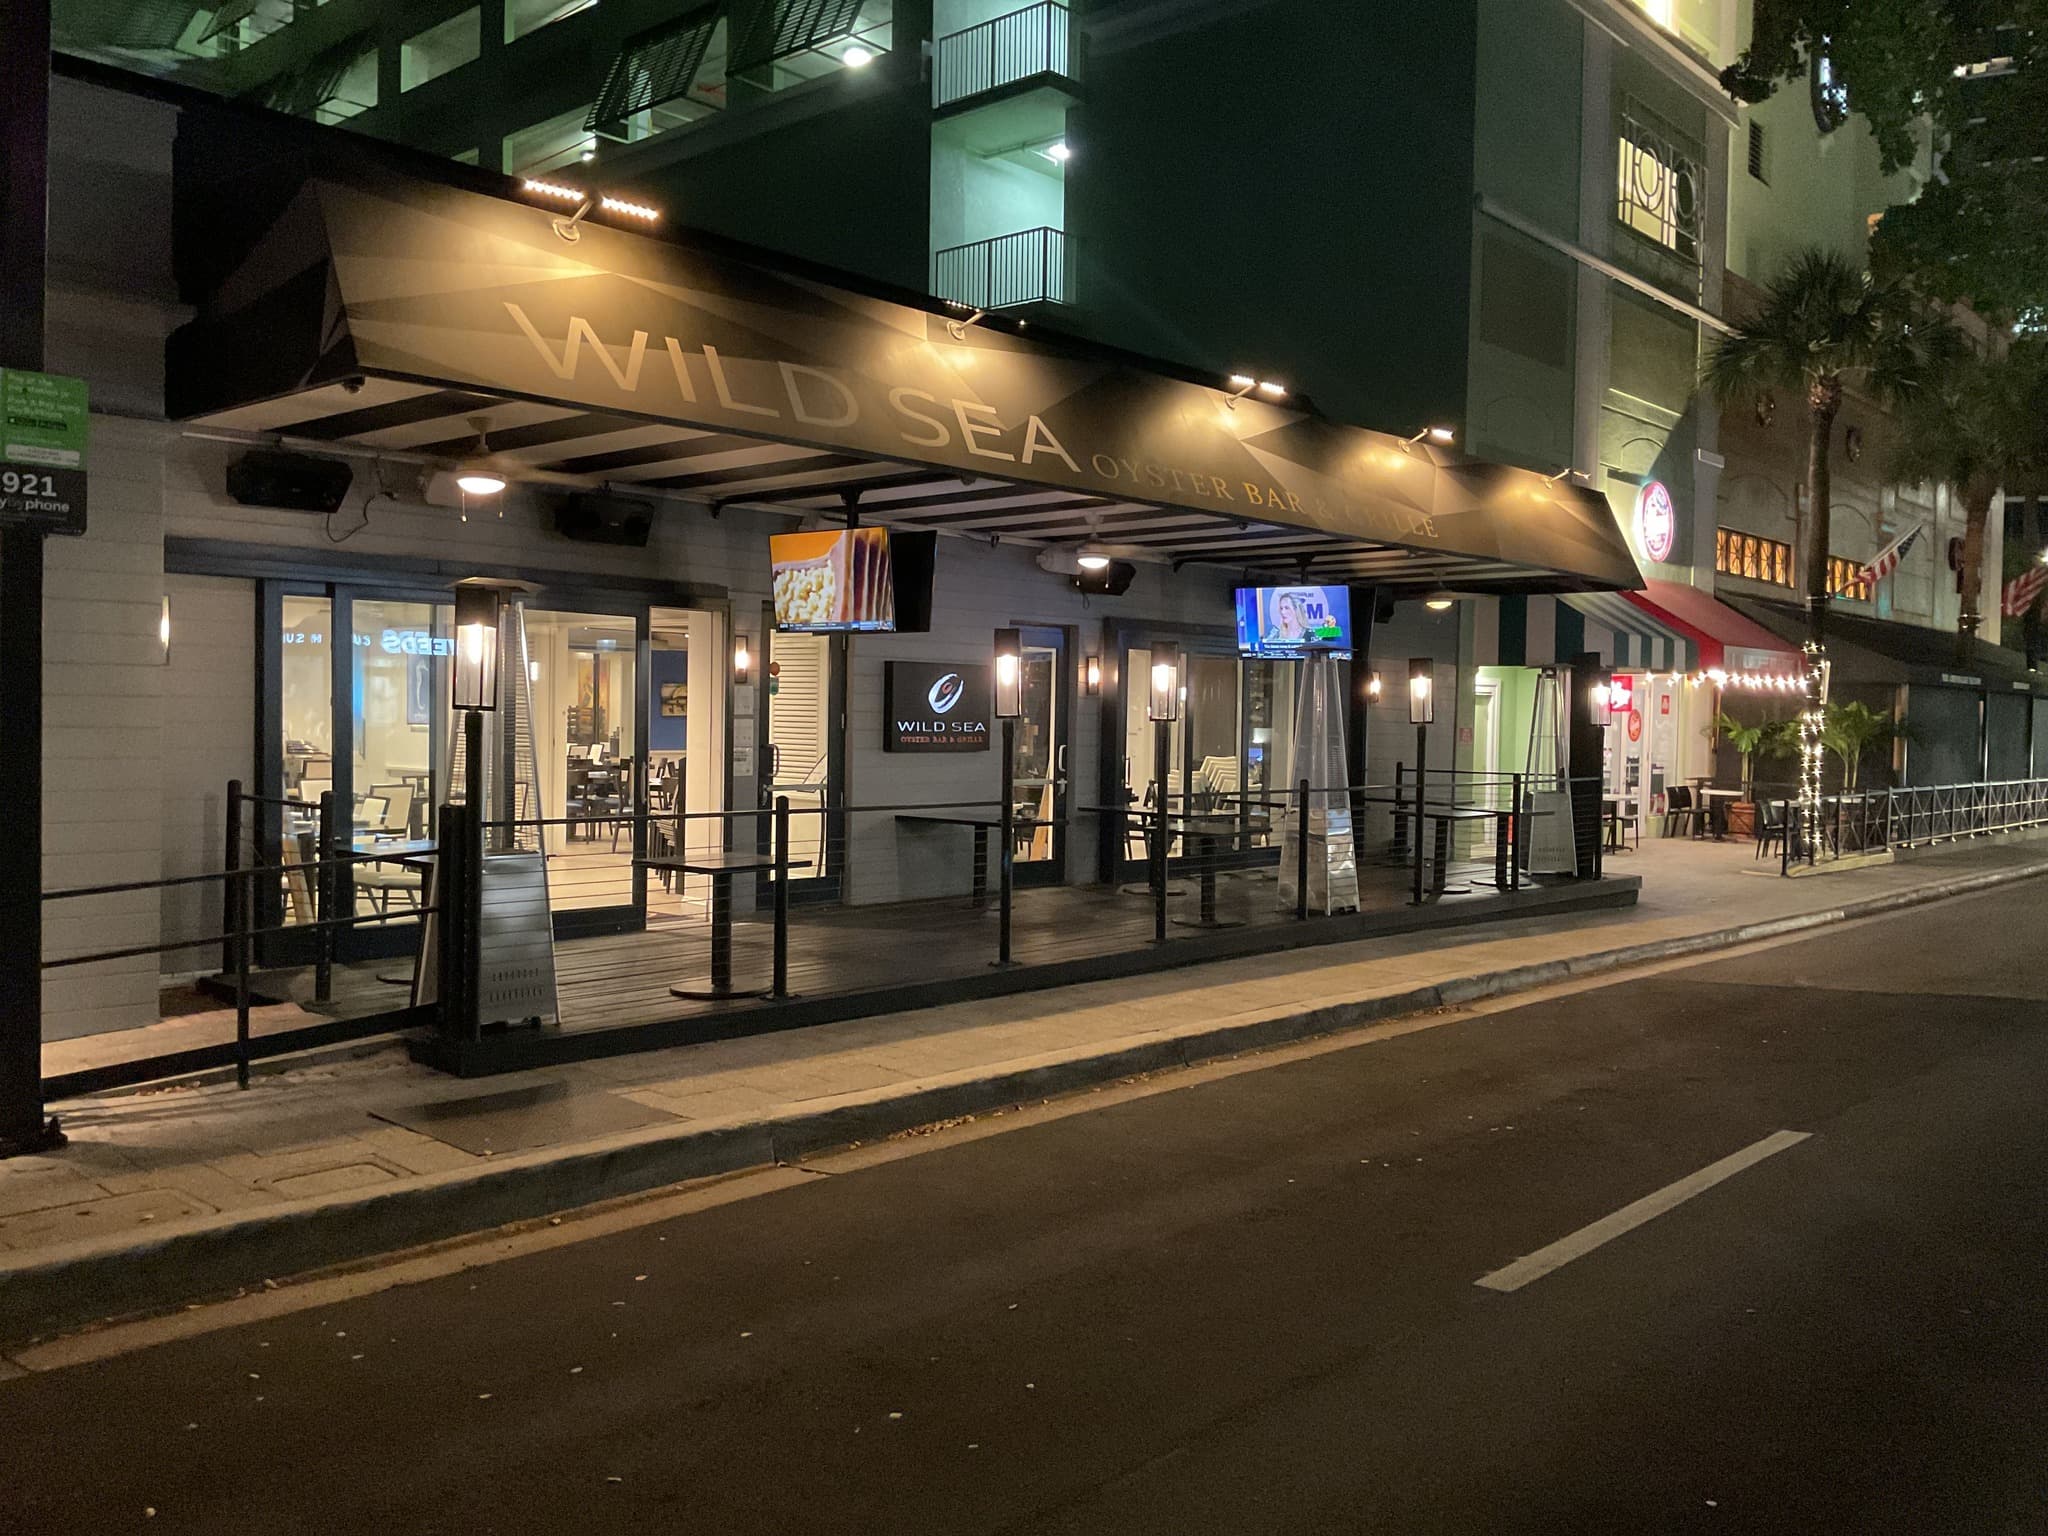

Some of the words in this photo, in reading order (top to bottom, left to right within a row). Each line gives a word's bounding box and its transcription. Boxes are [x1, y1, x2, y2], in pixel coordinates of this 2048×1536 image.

[504, 302, 860, 428] WILD
[888, 387, 1081, 472] SEA
[2, 471, 57, 497] 921
[1091, 454, 1235, 501] OYSTER
[1243, 481, 1307, 515] BAR
[897, 721, 945, 732] WILD
[951, 721, 986, 732] SEA
